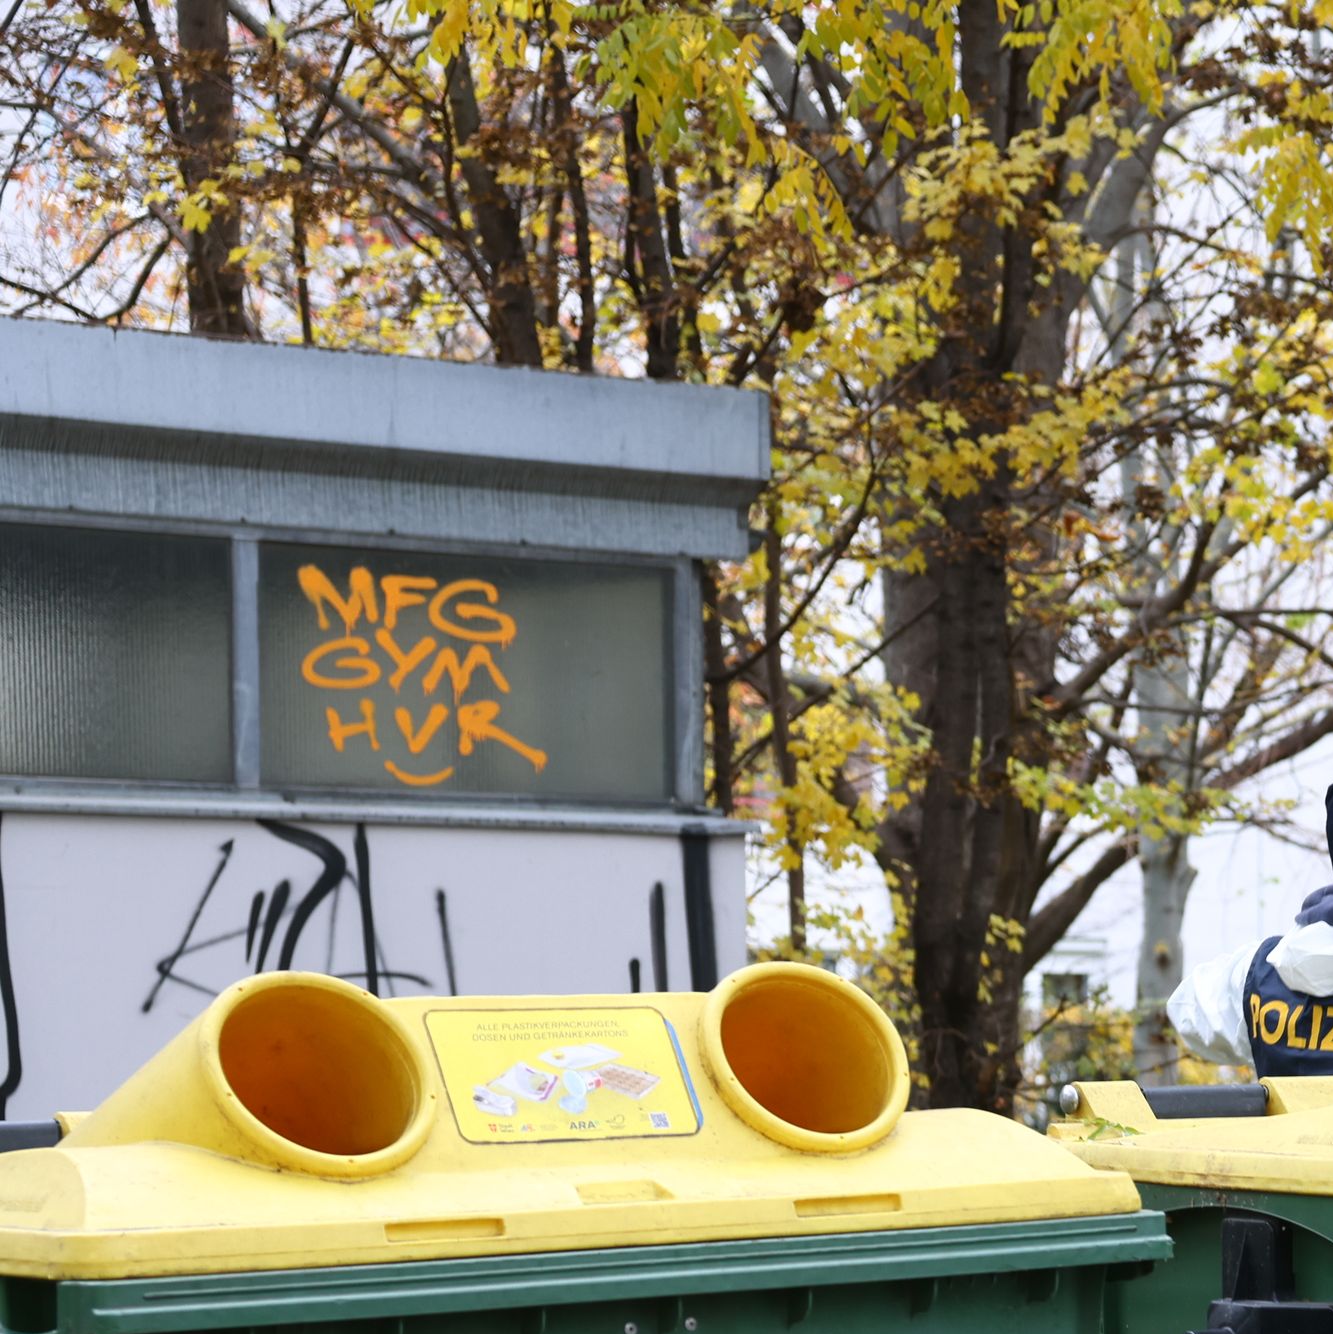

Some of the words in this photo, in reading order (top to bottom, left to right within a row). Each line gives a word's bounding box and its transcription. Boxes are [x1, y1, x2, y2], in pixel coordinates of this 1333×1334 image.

[298, 564, 516, 645] MFG
[301, 628, 511, 696] GYM
[476, 1022, 498, 1031] ALLE
[472, 1032, 506, 1042] DOSEN
[509, 1031, 531, 1041] UND
[569, 1120, 597, 1130] ARA
